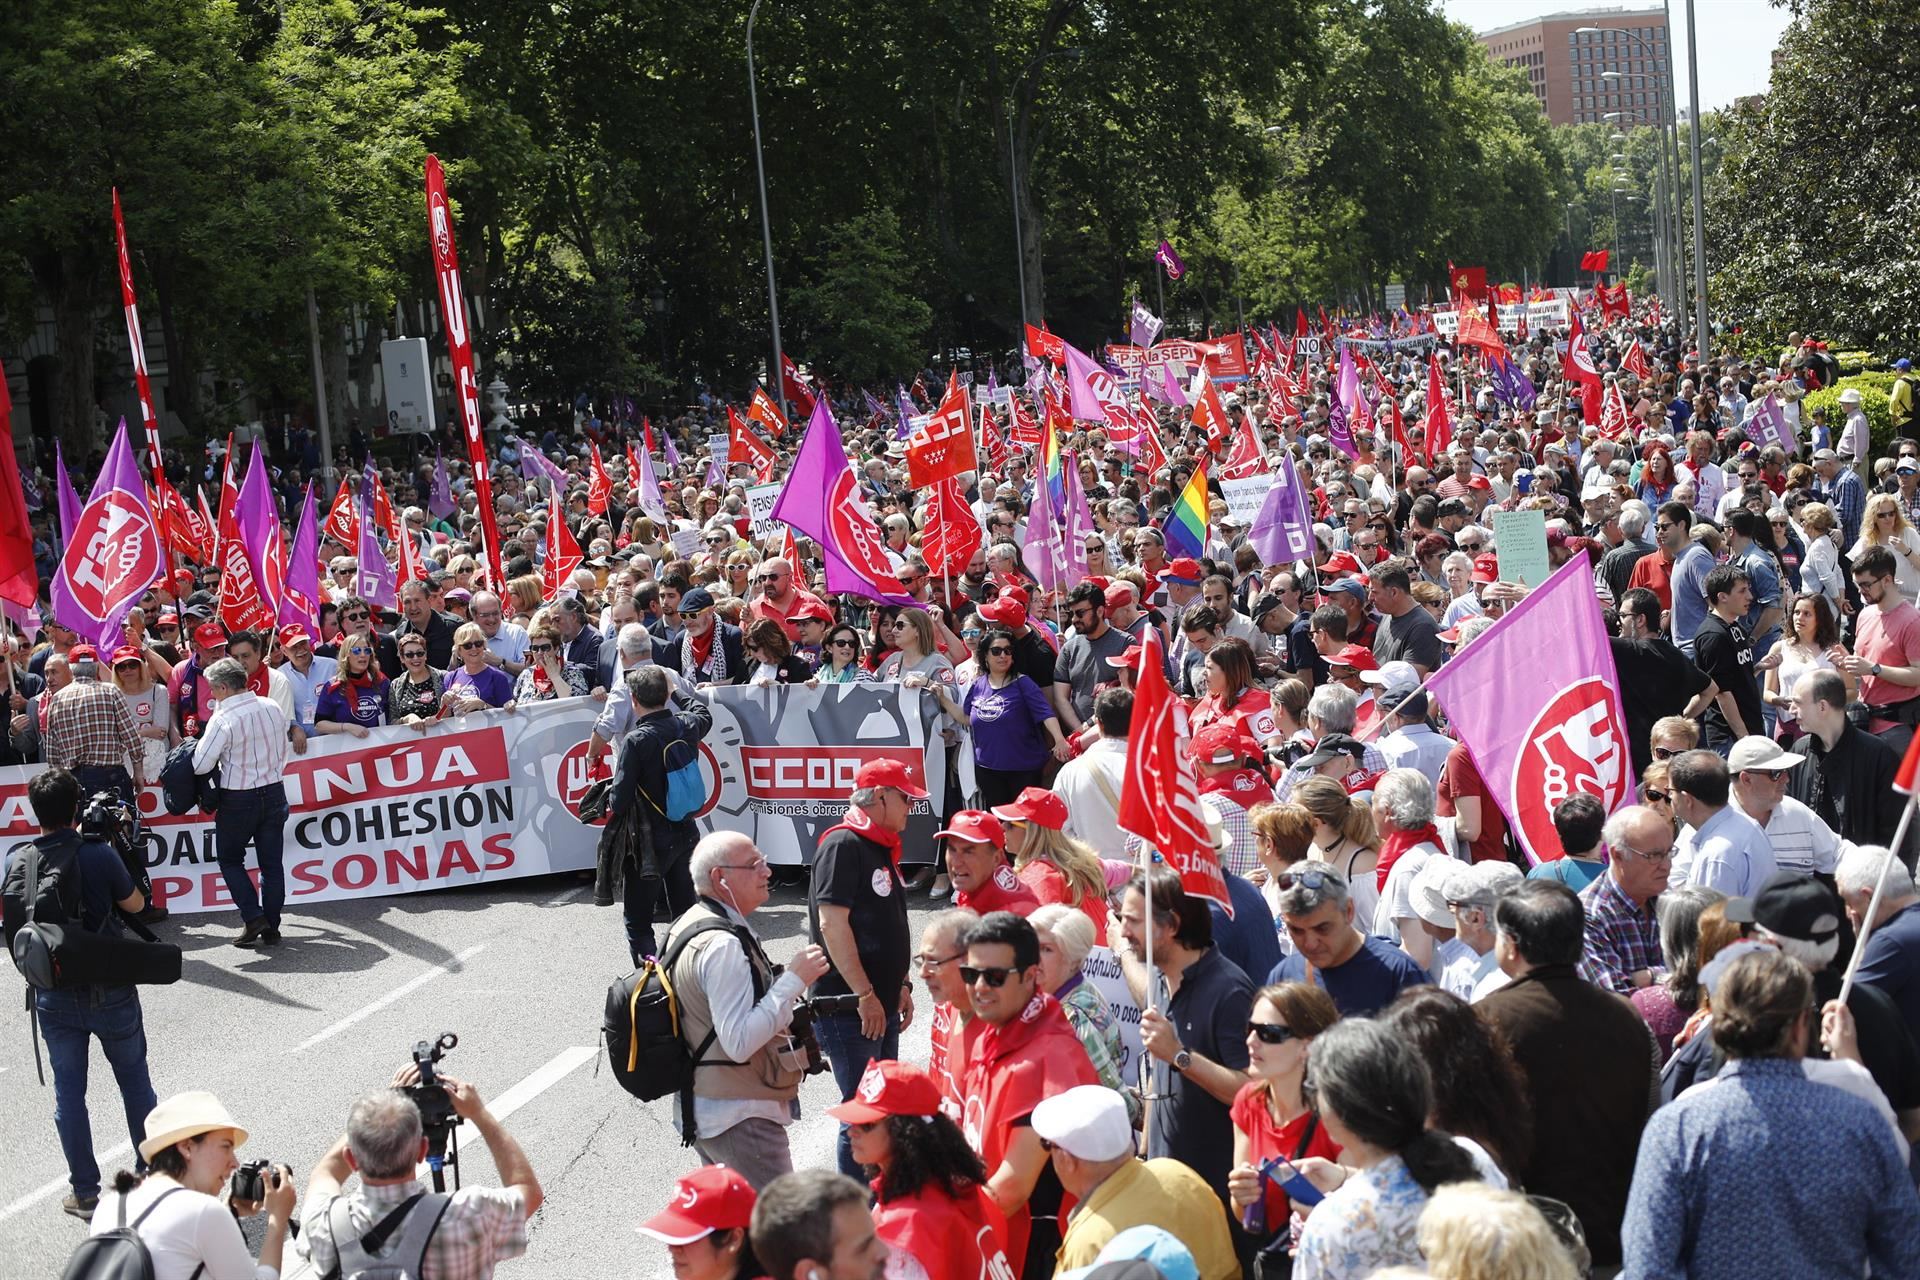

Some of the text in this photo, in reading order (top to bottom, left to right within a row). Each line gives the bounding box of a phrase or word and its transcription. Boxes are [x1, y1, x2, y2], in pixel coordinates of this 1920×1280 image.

[1150, 351, 1159, 362] la
[1161, 347, 1193, 361] SEPI
[1298, 339, 1319, 353] NO
[751, 490, 779, 517] ¡PENSIÓ
[749, 757, 862, 789] CCOO
[294, 783, 514, 849] COHESIÓN
[812, 801, 851, 817] obrera
[150, 832, 516, 909] PESONAS
